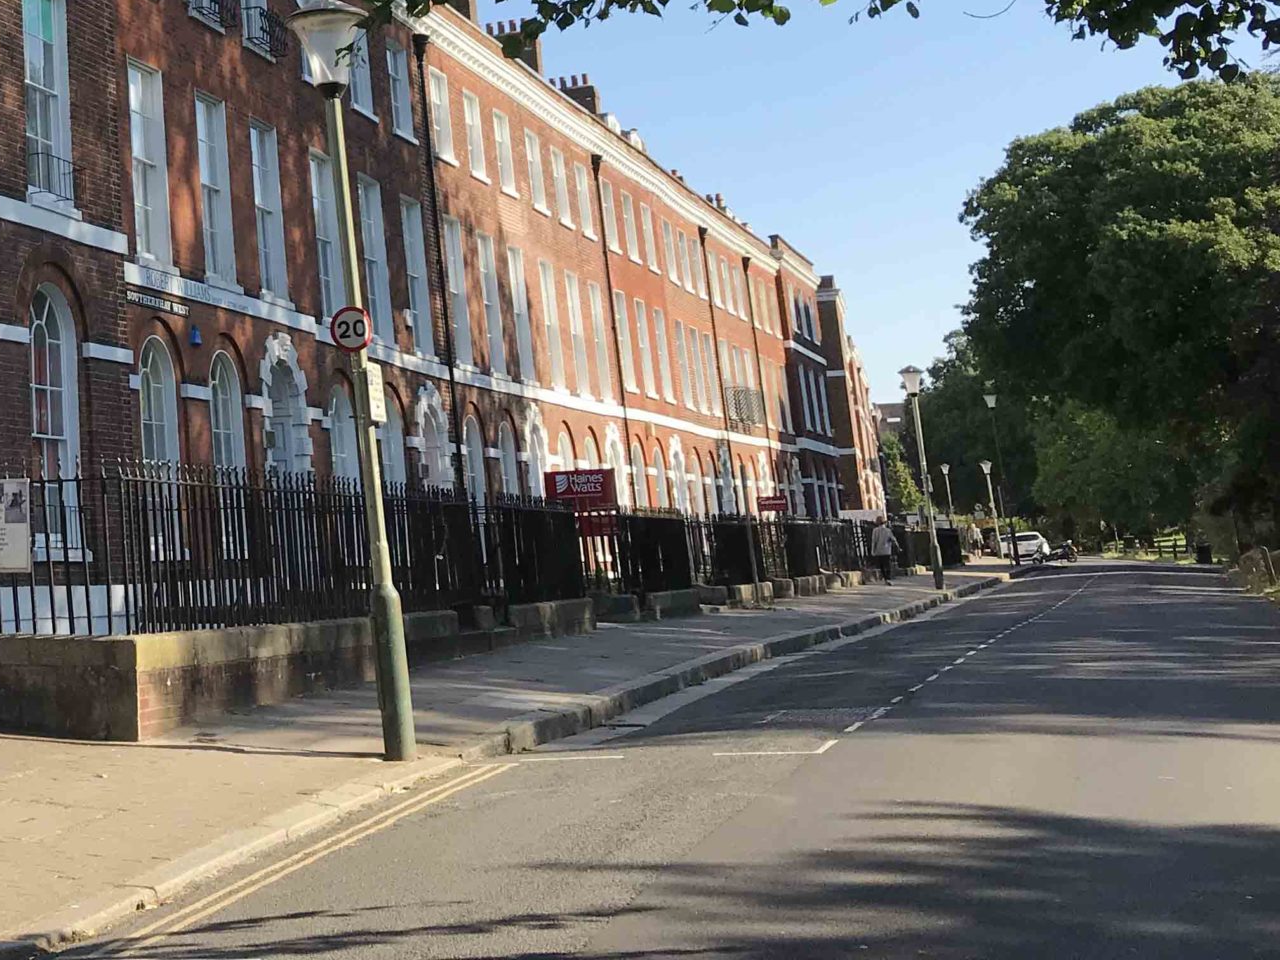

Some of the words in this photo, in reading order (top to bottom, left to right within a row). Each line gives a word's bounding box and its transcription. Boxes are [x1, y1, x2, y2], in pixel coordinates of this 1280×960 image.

[171, 302, 190, 316] WEST
[337, 319, 366, 339] 20
[569, 473, 604, 483] Haines
[570, 482, 602, 492] Watts
